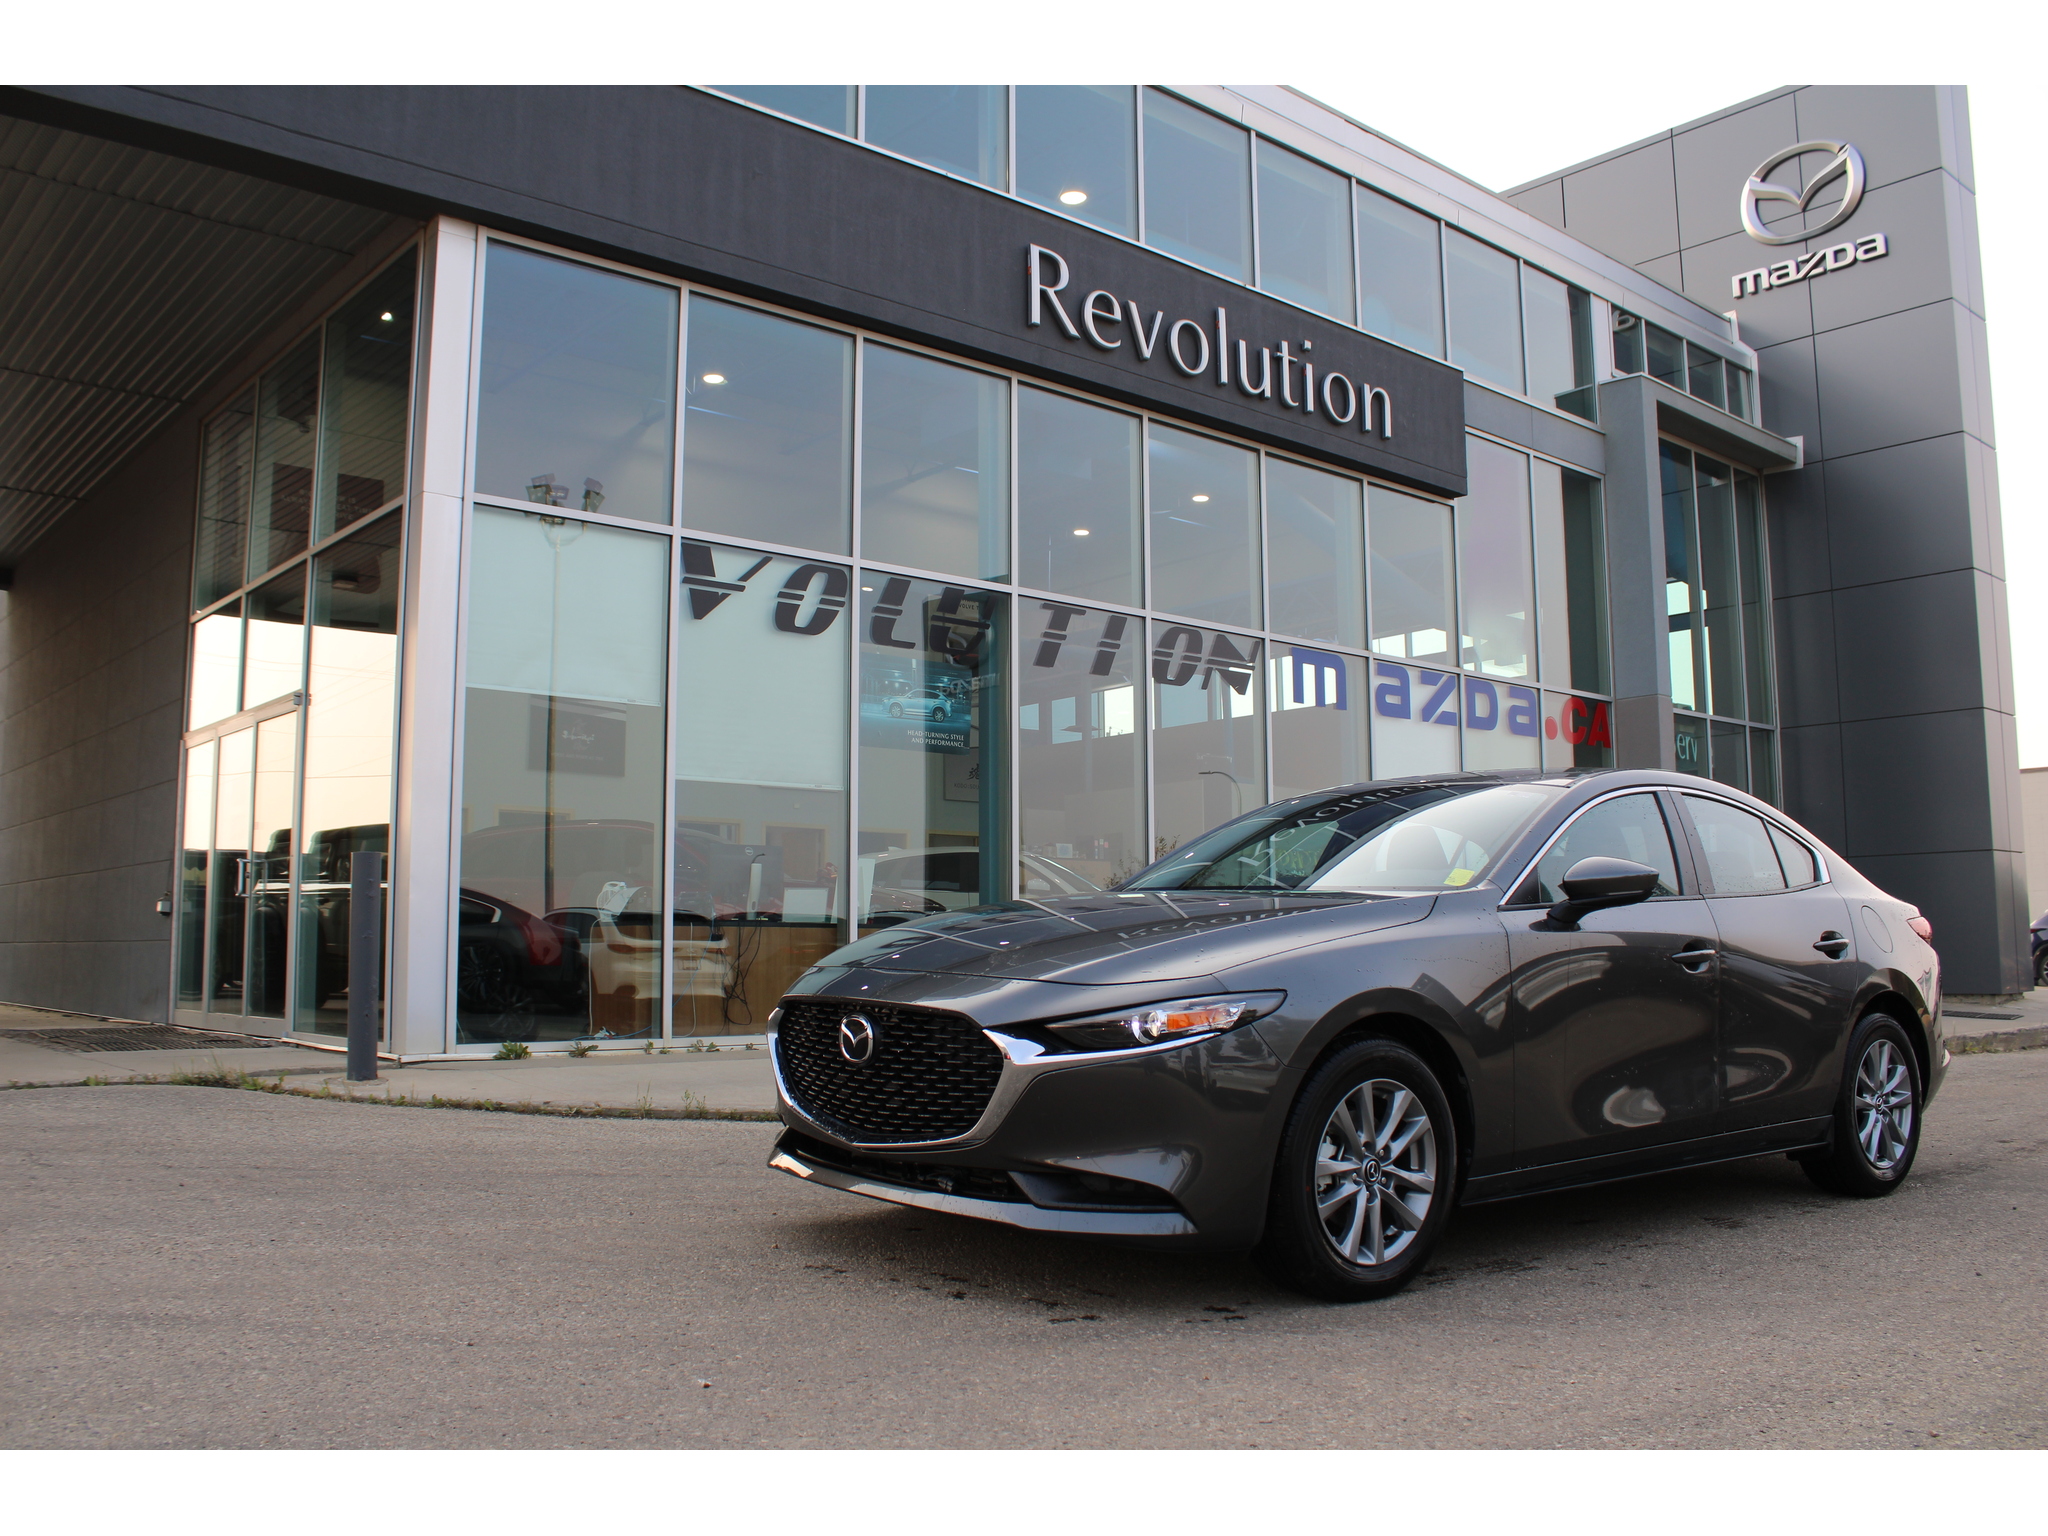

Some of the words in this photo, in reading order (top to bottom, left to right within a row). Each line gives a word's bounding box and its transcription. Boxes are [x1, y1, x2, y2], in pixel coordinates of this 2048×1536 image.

[1731, 232, 1888, 299] mazda
[1027, 242, 1392, 440] Revolution
[907, 729, 949, 740] HEAD-TURNING
[950, 733, 964, 741] STYLE
[925, 738, 964, 748] PERFORMANCE
